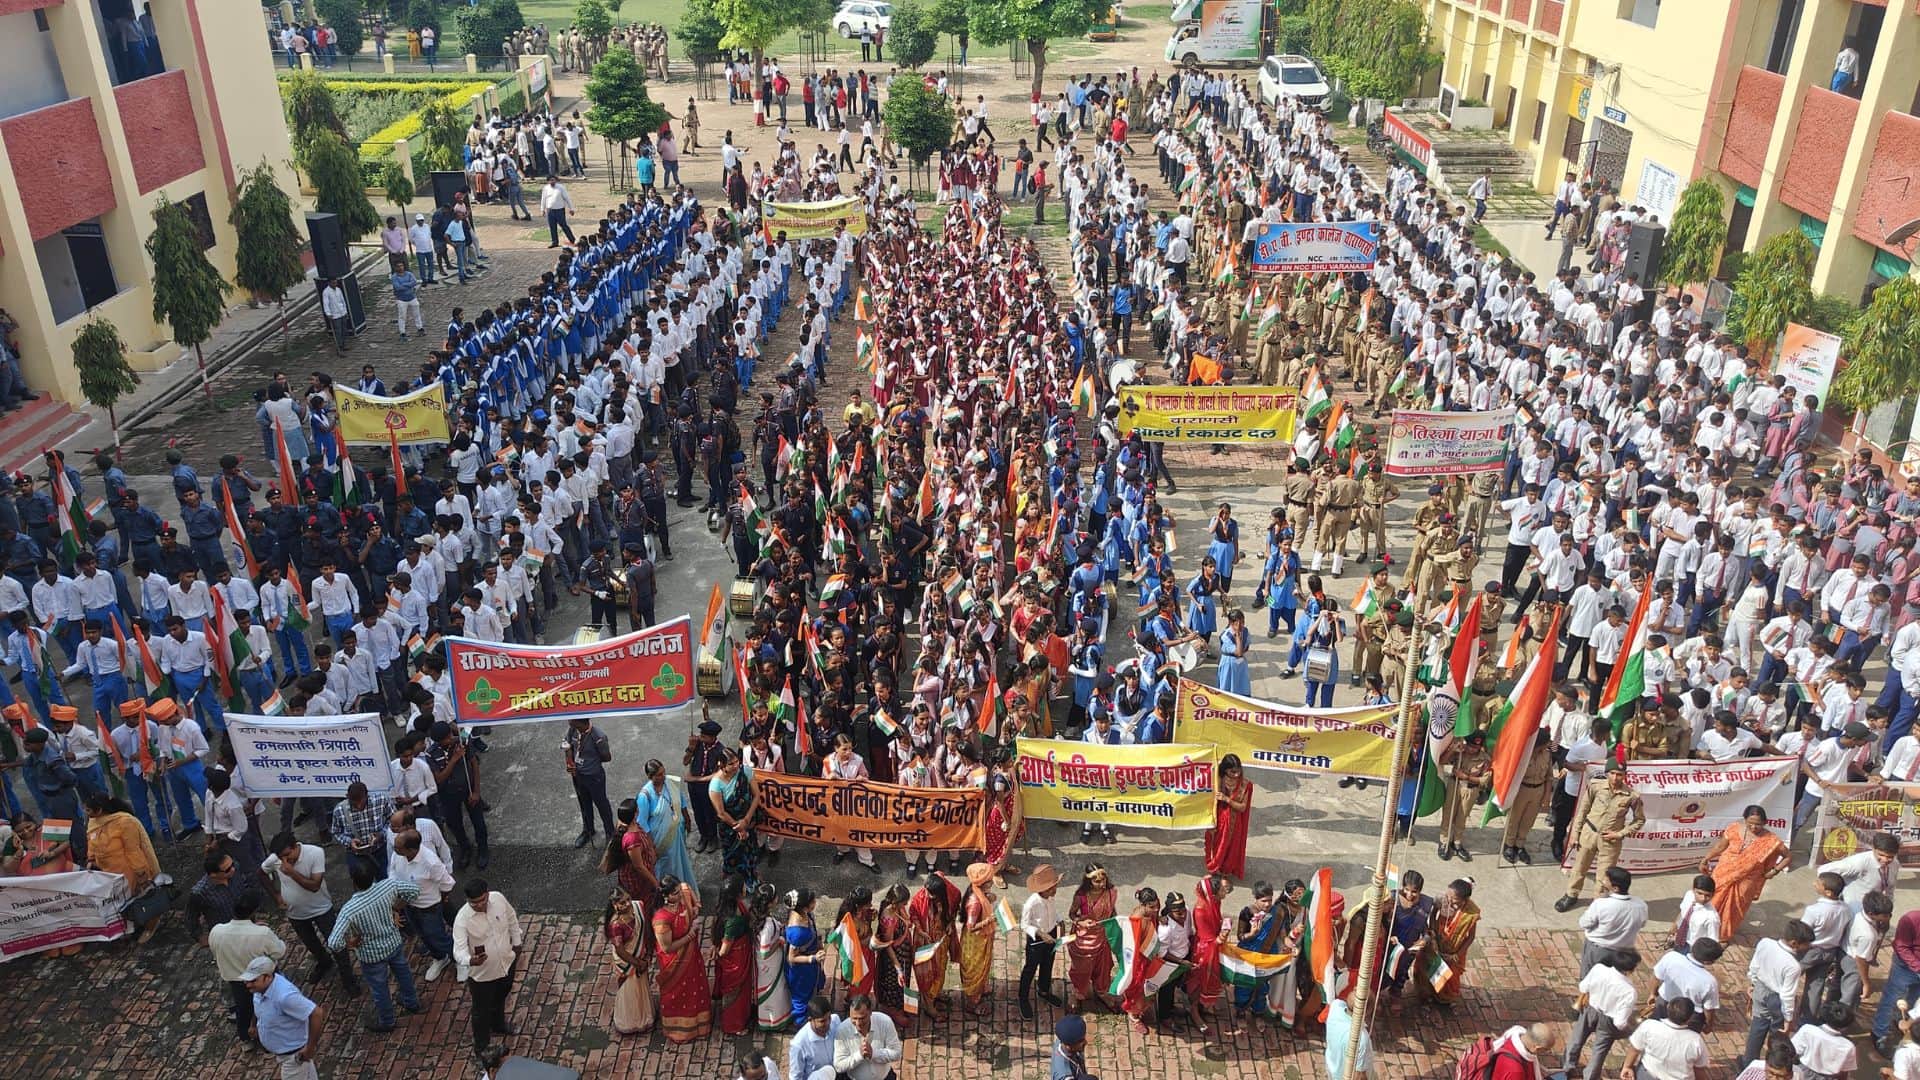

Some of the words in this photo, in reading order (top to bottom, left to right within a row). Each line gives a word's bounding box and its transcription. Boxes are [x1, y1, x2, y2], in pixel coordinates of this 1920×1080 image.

[1295, 228, 1315, 245] इण्टर
[1344, 231, 1376, 258] वाराणसी
[1198, 392, 1216, 411] आदर्श
[1258, 395, 1273, 412] इण्टर
[1169, 415, 1238, 424] वाराणसी
[1133, 426, 1181, 438] आदर्श
[1186, 428, 1243, 438] स्काउट
[1248, 428, 1277, 439] दल
[1460, 428, 1494, 440] यात्रा
[459, 651, 529, 673] राजकीय
[557, 686, 613, 707] स्काउट
[616, 684, 646, 703] दल
[1193, 707, 1250, 723] राजकीय
[1255, 709, 1308, 728] बालिका
[1313, 716, 1351, 732] इण्टर
[253, 739, 316, 751] कमलापति
[318, 737, 361, 751] त्रिपाठी
[294, 758, 329, 770] इण्टर
[332, 755, 375, 768] कॉलेज
[1252, 751, 1332, 768] वाराणसी
[312, 772, 361, 784] वाराणसी
[1020, 751, 1056, 786] आर्य
[1059, 753, 1112, 790] महिला
[1114, 765, 1157, 794] इण्टर
[1158, 755, 1213, 793] कालेज
[1653, 768, 1694, 792] पुलिस
[1724, 766, 1776, 783] कार्यक्रम
[831, 781, 892, 820] बालिका
[891, 790, 932, 824] इंटर
[1061, 797, 1174, 817] चेतगंज-वाराणसी
[1839, 800, 1905, 817] सनातन
[848, 829, 932, 845] वाराणसी
[1647, 830, 1671, 842] इण्टर
[11, 897, 53, 910] Daughters
[54, 893, 62, 901] of
[15, 905, 63, 923] Distribution
[64, 903, 72, 911] of
